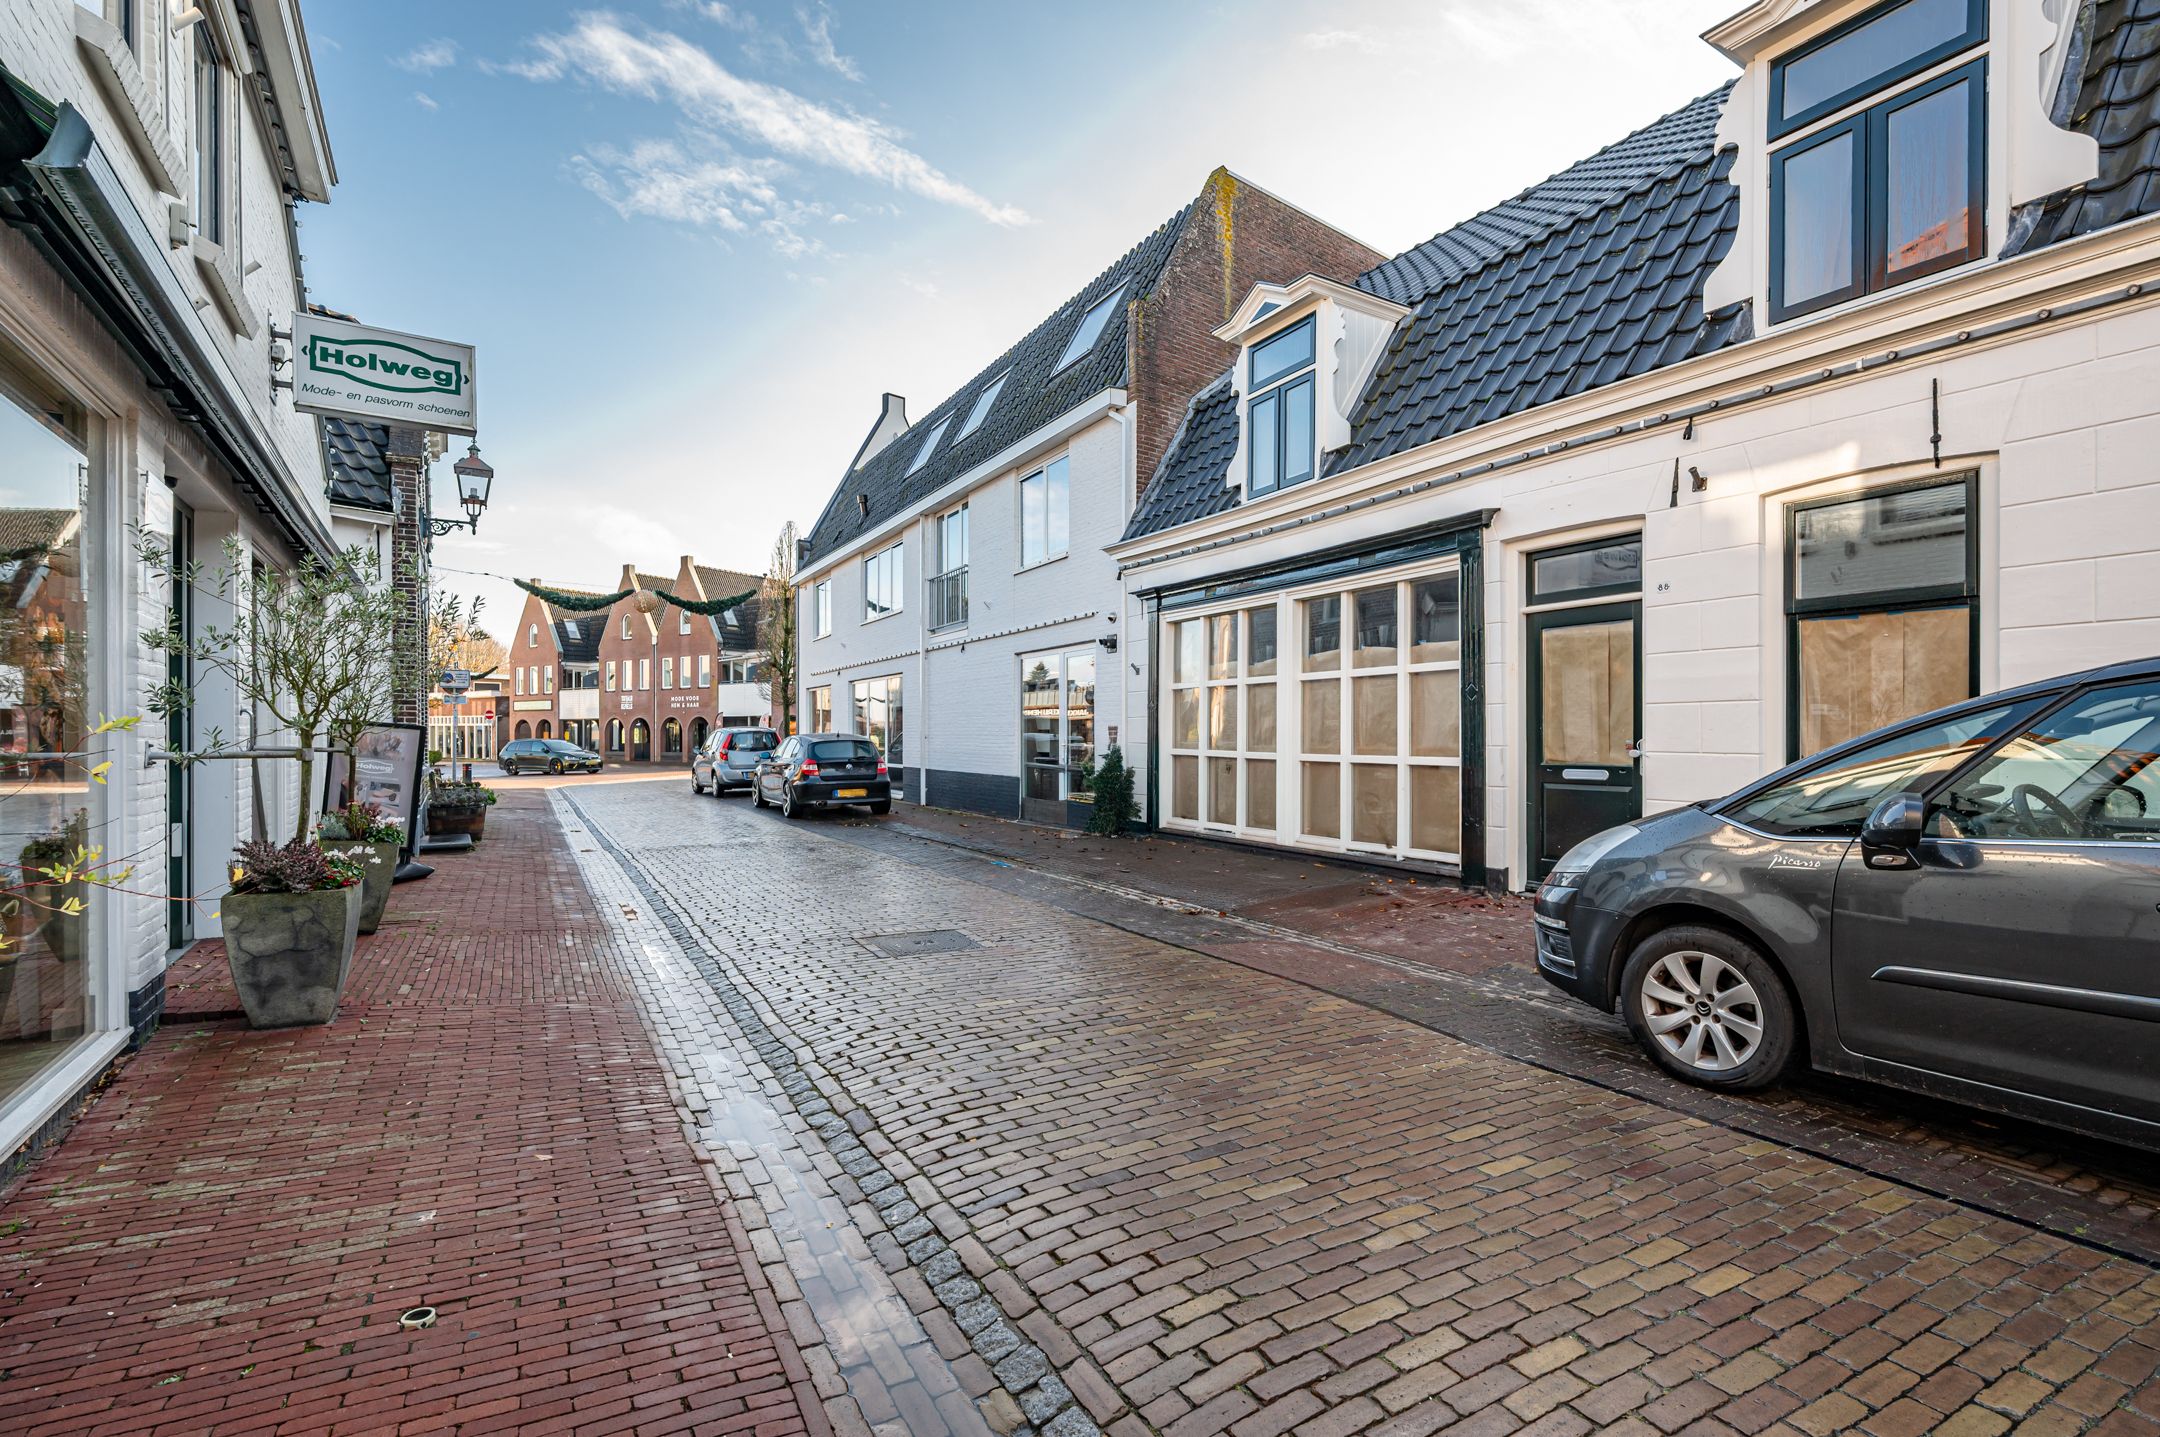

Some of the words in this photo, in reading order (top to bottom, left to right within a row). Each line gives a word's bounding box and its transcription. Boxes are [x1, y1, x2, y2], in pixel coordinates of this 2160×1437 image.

[319, 347, 453, 387] Holweg
[301, 383, 343, 396] Mode-
[346, 391, 361, 401] en
[364, 394, 414, 409] pasvorm
[417, 402, 471, 418] schoenen
[1768, 854, 1821, 870] Picasso
